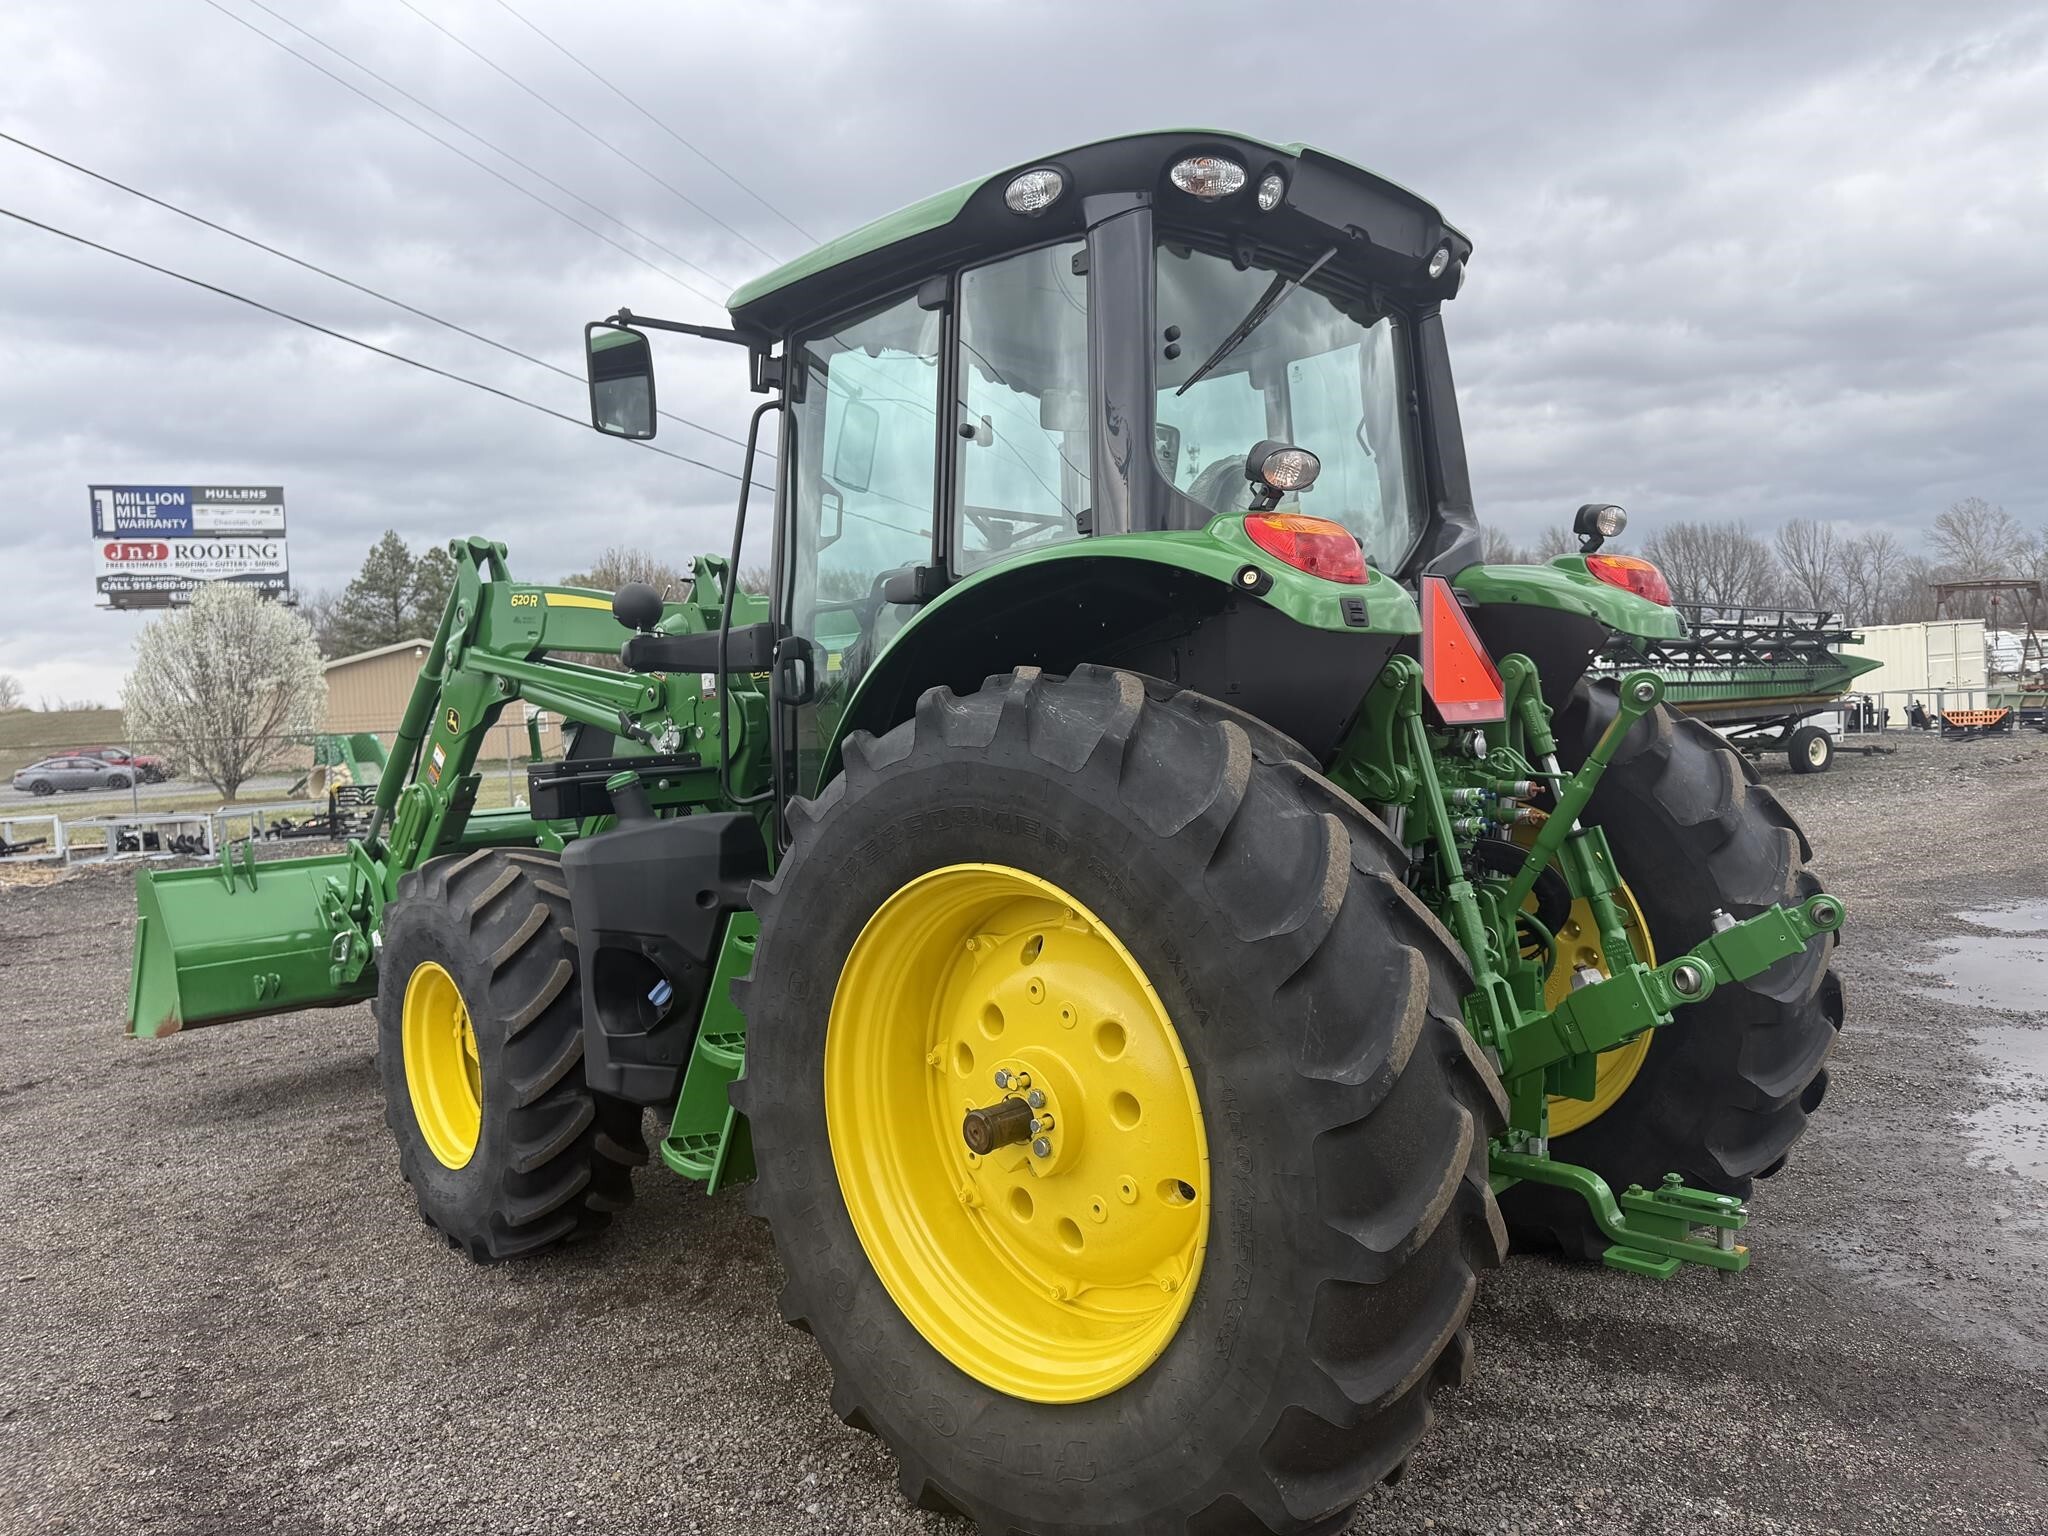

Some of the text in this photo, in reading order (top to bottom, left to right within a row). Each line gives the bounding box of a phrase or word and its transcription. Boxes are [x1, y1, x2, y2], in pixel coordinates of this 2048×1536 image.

[115, 492, 185, 506] MILLION
[205, 490, 267, 499] MULLENS
[94, 489, 115, 532] 1
[116, 505, 157, 518] MILE
[117, 519, 187, 529] WARRANTY
[111, 543, 278, 560] JnJ ROOFING
[175, 561, 208, 569] ROOFING
[215, 560, 248, 568] GUTTERS
[255, 560, 280, 568] SIDING
[101, 581, 131, 591] CALL
[269, 579, 285, 588] OK
